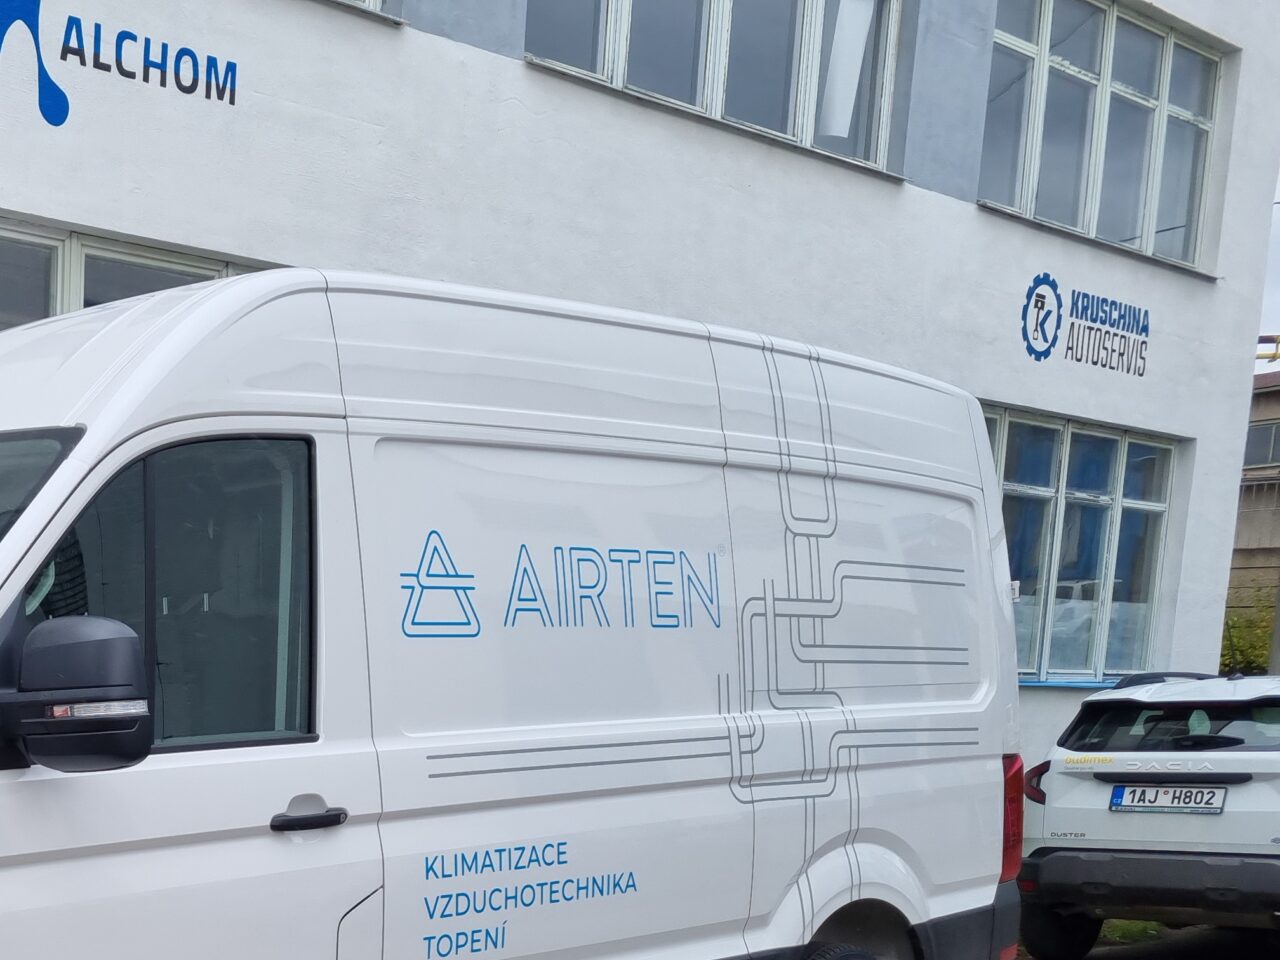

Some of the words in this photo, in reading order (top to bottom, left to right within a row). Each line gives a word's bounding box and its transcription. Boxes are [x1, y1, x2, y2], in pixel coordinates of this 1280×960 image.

[60, 15, 237, 106] ALCHOM
[1069, 289, 1150, 338] KRUSCHINA
[1064, 321, 1148, 377] AUTOSERVIS
[504, 544, 720, 628] AIRTEN
[1127, 761, 1215, 771] DACIA
[1129, 788, 1159, 804] 1AJ
[1171, 789, 1216, 806] H802
[425, 841, 568, 880] KLIMATIZACE
[424, 872, 638, 919] VZDUCHOTECHNIKA
[423, 920, 508, 960] TOPENÍ
